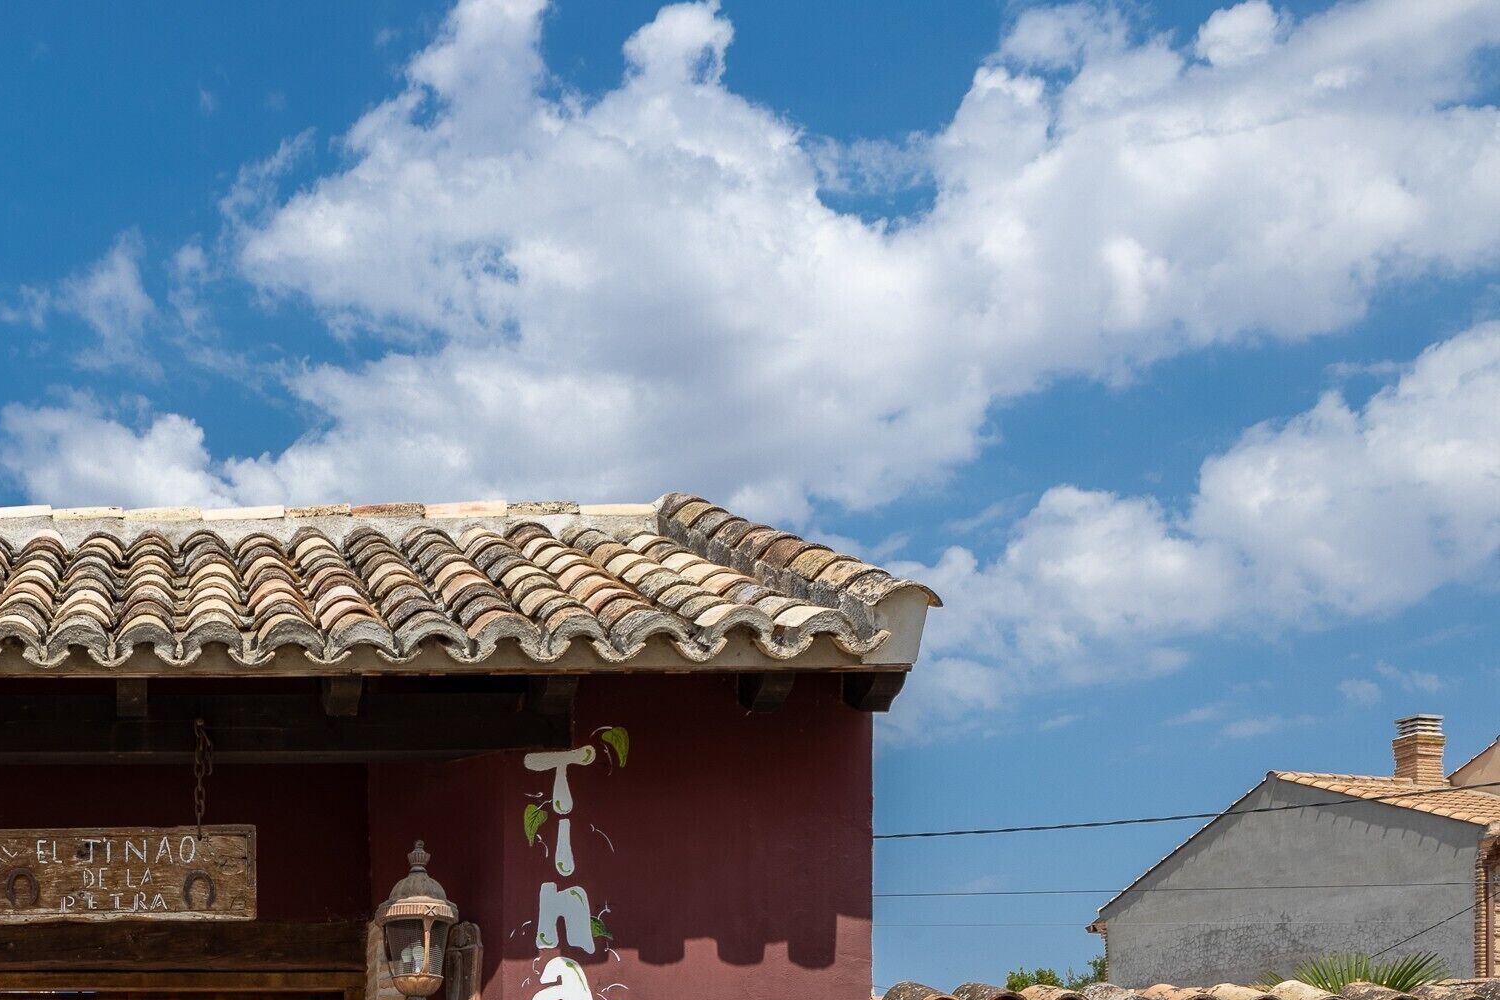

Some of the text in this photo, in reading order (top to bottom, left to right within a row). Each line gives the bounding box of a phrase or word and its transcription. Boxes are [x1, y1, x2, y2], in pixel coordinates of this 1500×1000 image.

[36, 835, 197, 865] EL TINAO
[82, 867, 154, 889] DE LA
[60, 891, 169, 913] PETRA
